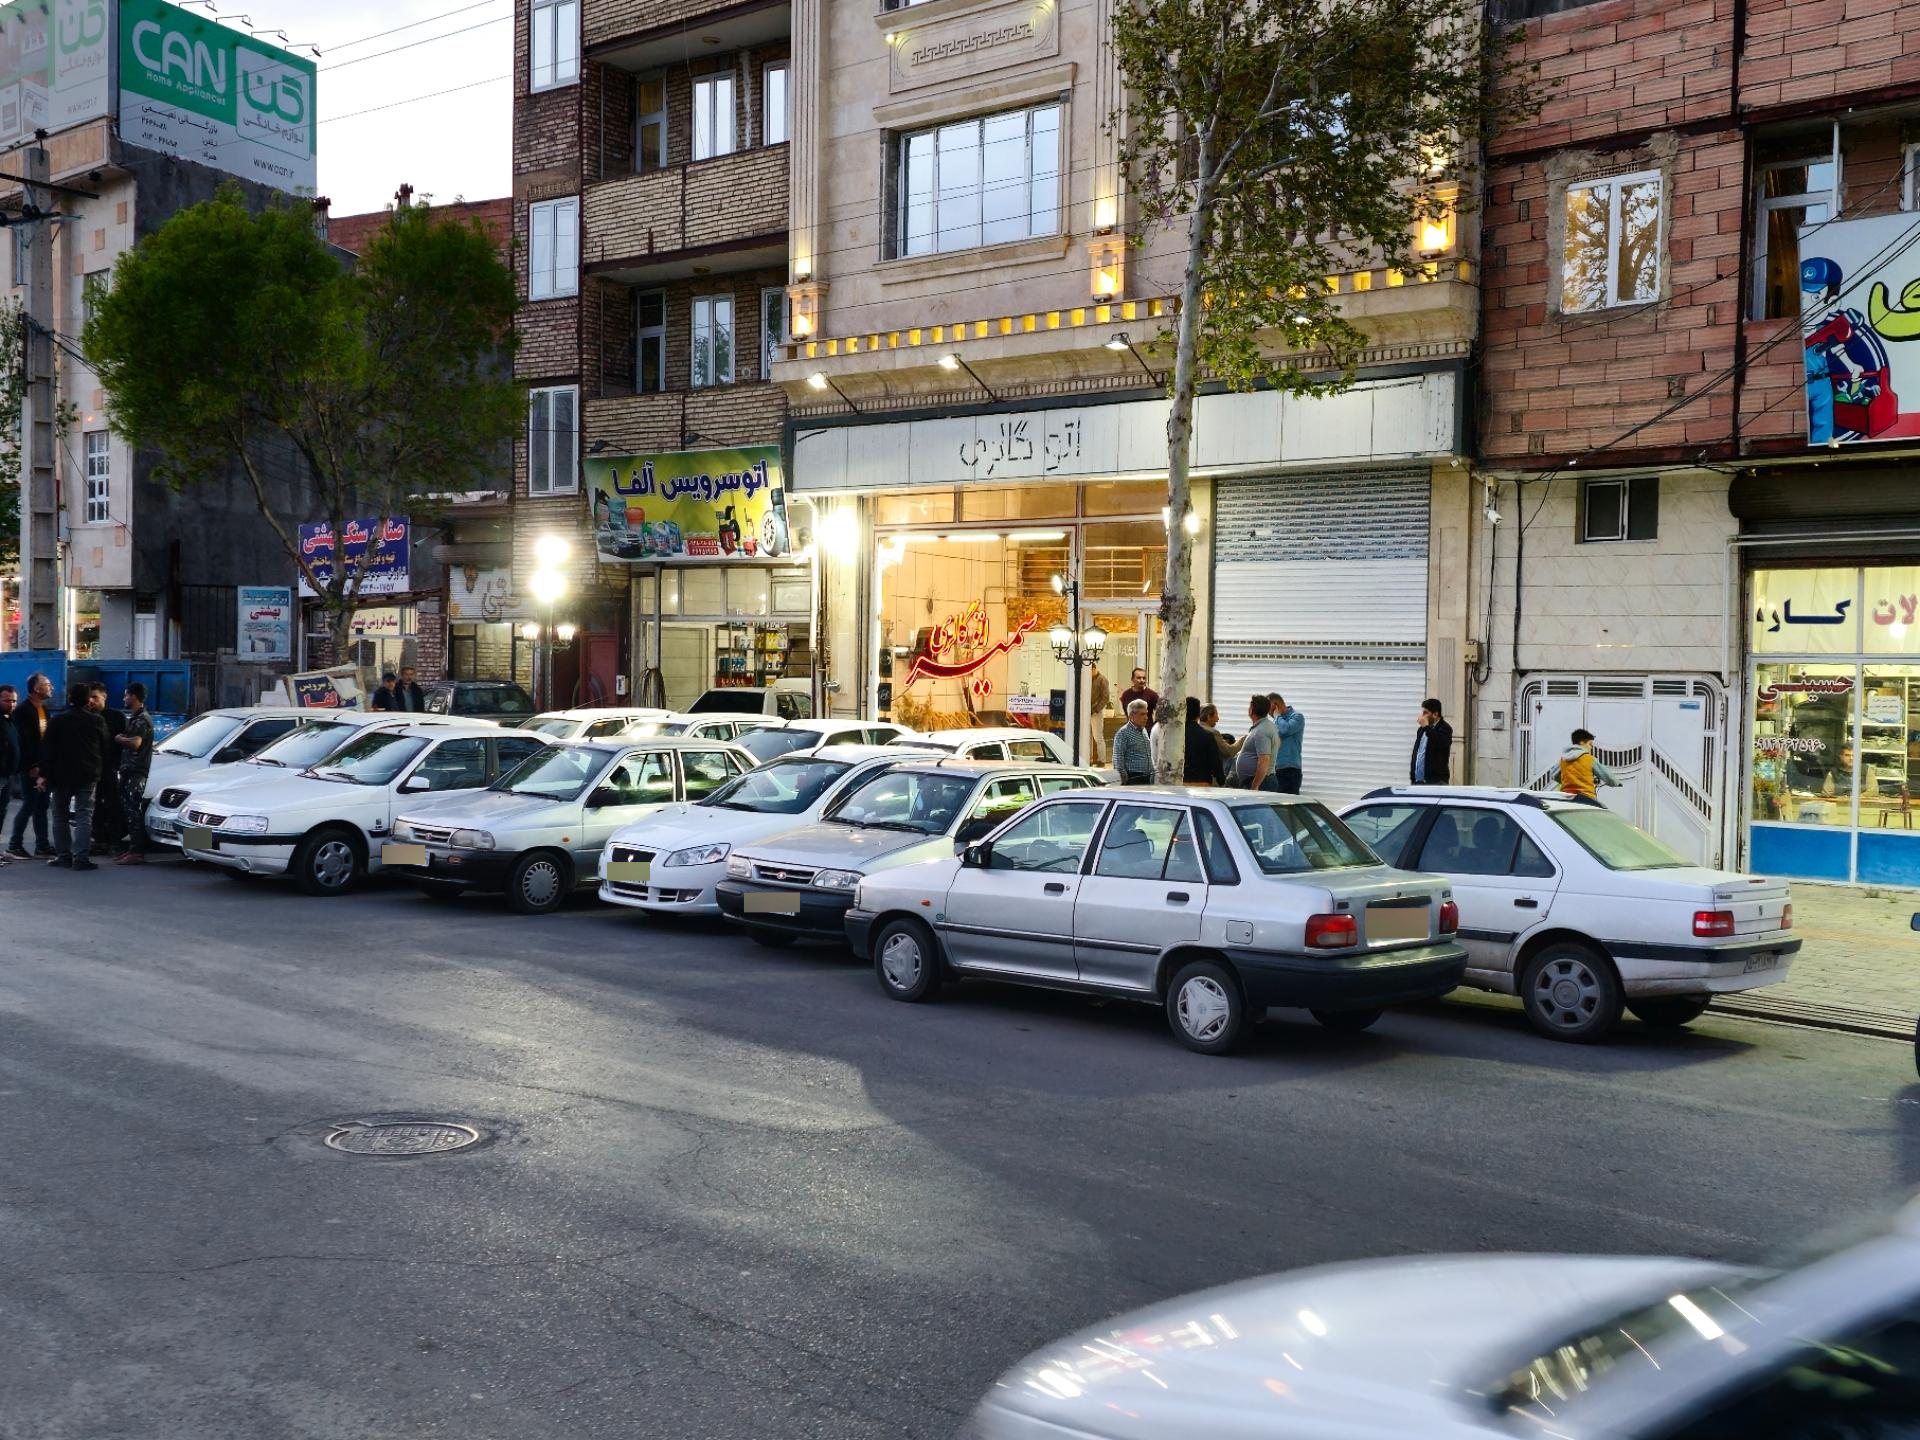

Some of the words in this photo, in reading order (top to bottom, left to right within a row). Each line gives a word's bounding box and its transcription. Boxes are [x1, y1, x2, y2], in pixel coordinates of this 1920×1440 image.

[132, 19, 227, 94] CAN
[146, 70, 173, 87] Home
[176, 81, 226, 106] Appliances
[243, 113, 281, 134] خانگی
[281, 128, 304, 144] لوازم
[611, 460, 656, 496] آلفا
[660, 458, 769, 502] اتوسرویس
[303, 523, 337, 555] هشتی
[1757, 597, 1852, 632] کار
[1872, 593, 1919, 626] لات
[1758, 667, 1856, 702] حسینی
